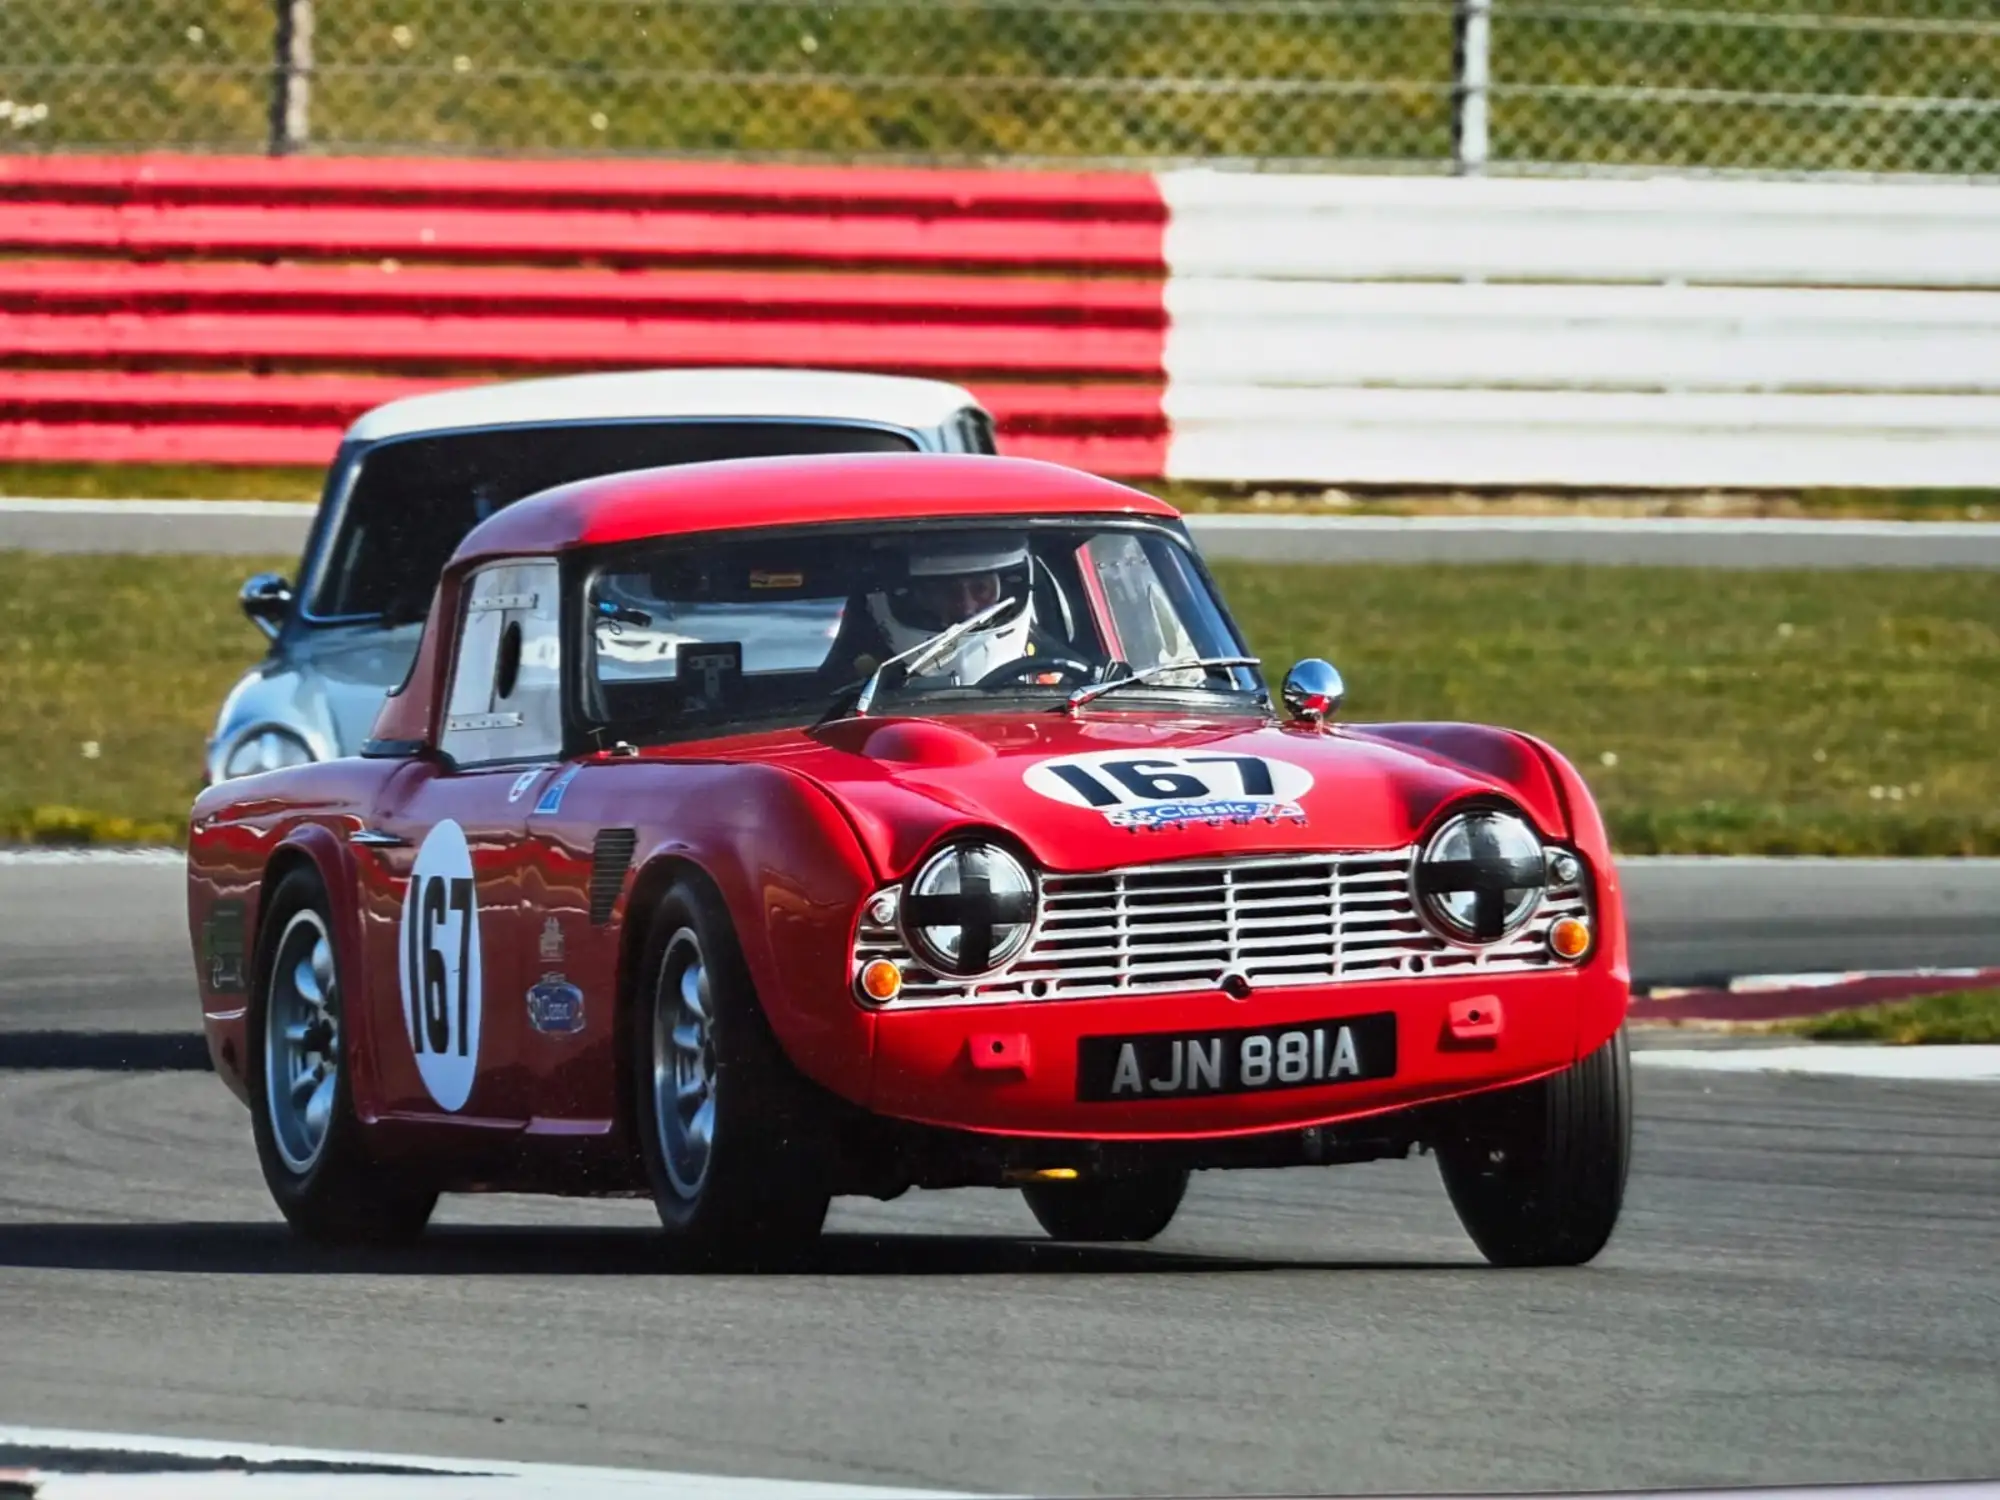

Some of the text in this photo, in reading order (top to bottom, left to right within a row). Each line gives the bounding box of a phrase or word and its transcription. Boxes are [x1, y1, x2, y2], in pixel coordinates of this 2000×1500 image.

[1046, 757, 1274, 807] 167
[1155, 803, 1250, 819] Classic
[408, 875, 473, 1057] 167
[1111, 1025, 1359, 1094] AJN 881A
